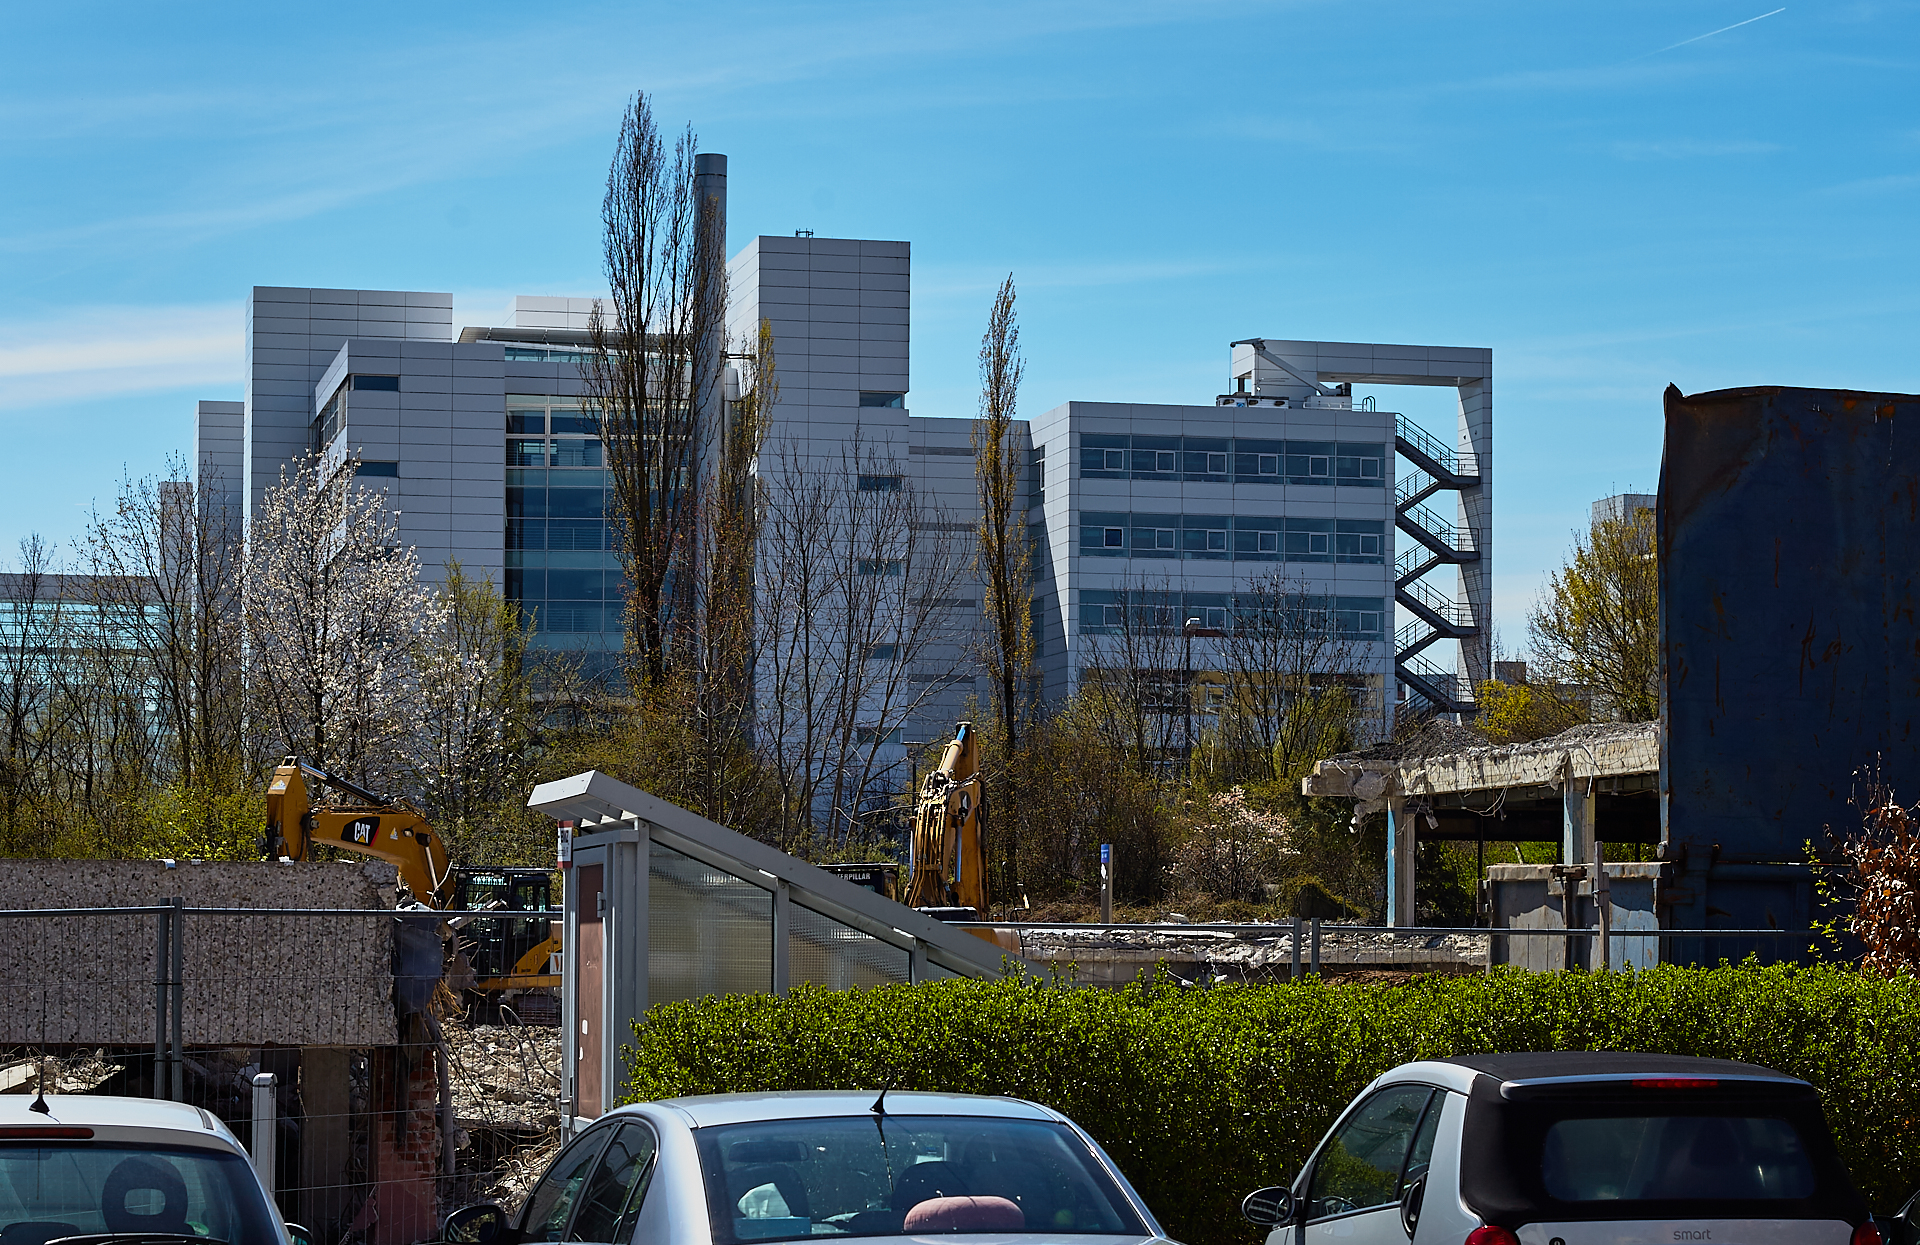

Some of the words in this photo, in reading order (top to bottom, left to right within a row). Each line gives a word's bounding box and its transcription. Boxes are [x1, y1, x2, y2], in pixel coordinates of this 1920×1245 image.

[354, 821, 371, 844] CAT
[837, 872, 871, 880] TERPILLAR
[1673, 1229, 1712, 1240] smart
